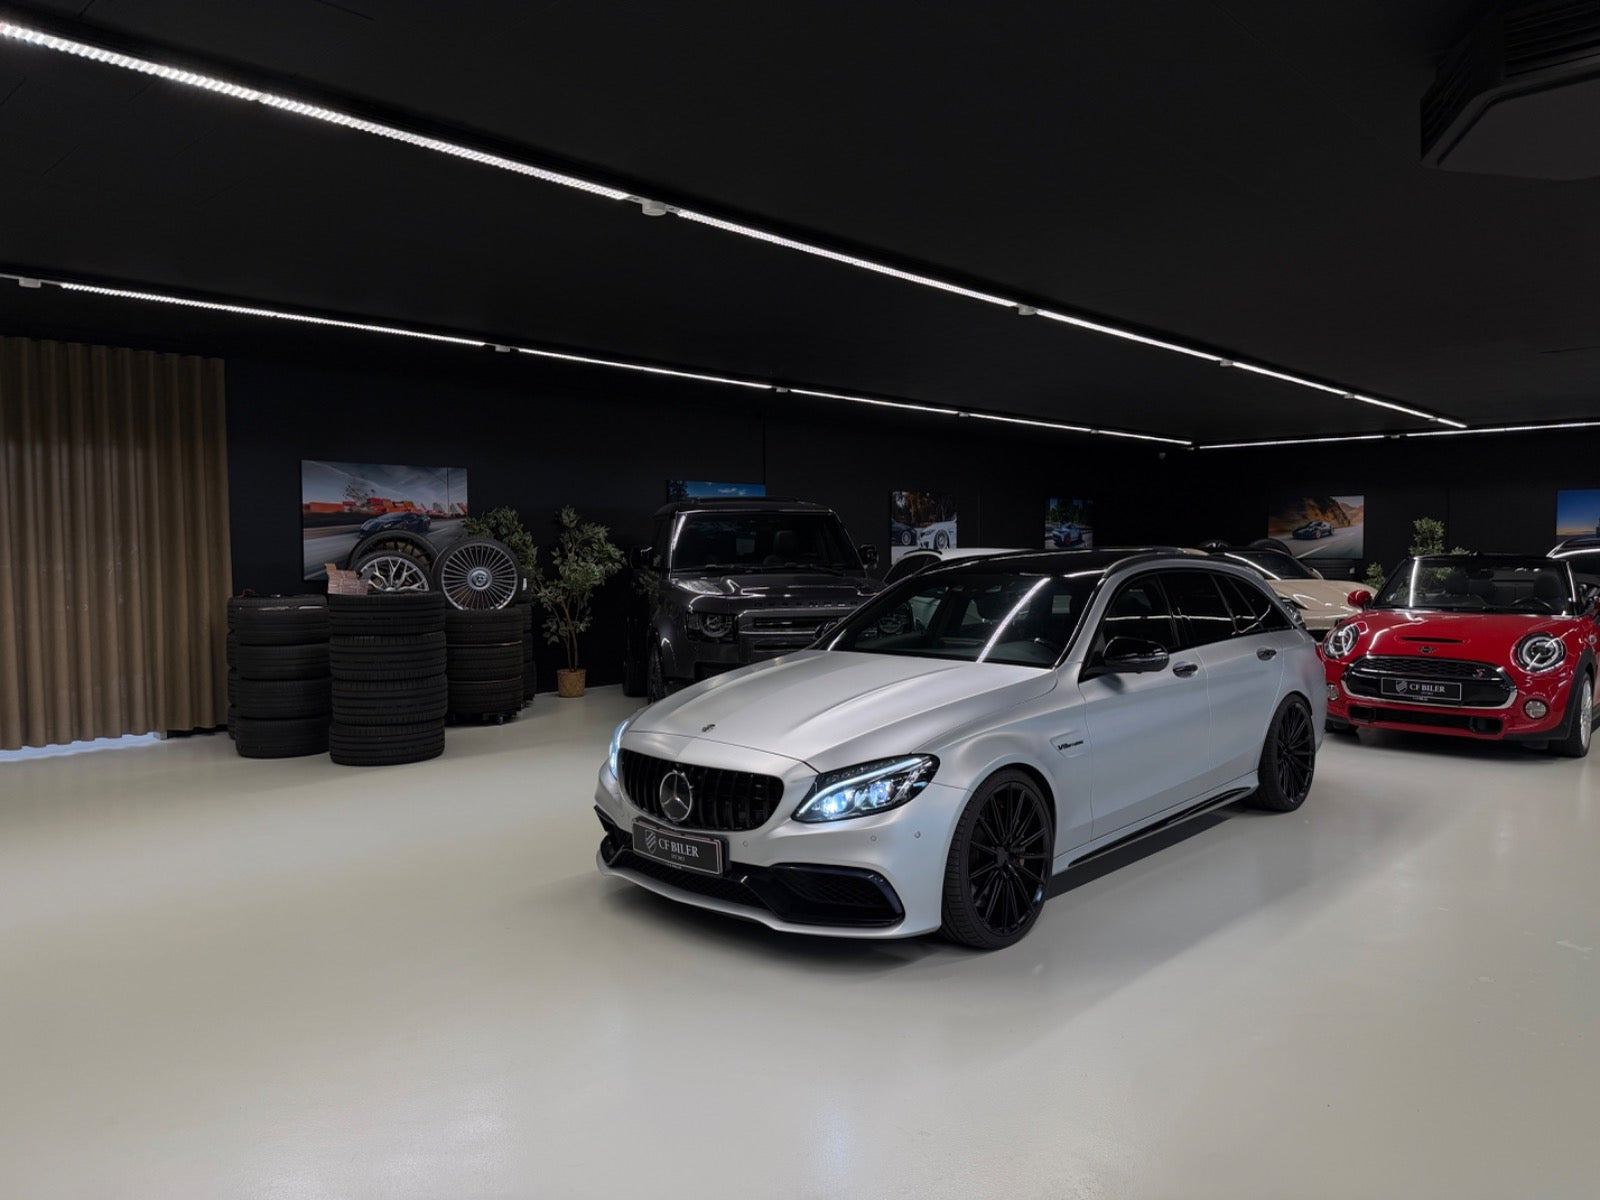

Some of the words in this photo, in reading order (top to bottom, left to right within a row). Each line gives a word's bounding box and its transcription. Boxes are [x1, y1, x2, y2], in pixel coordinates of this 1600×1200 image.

[1409, 683, 1420, 691] CF
[1421, 685, 1445, 693] BILER
[658, 838, 669, 850] CF
[670, 841, 699, 857] BILER
